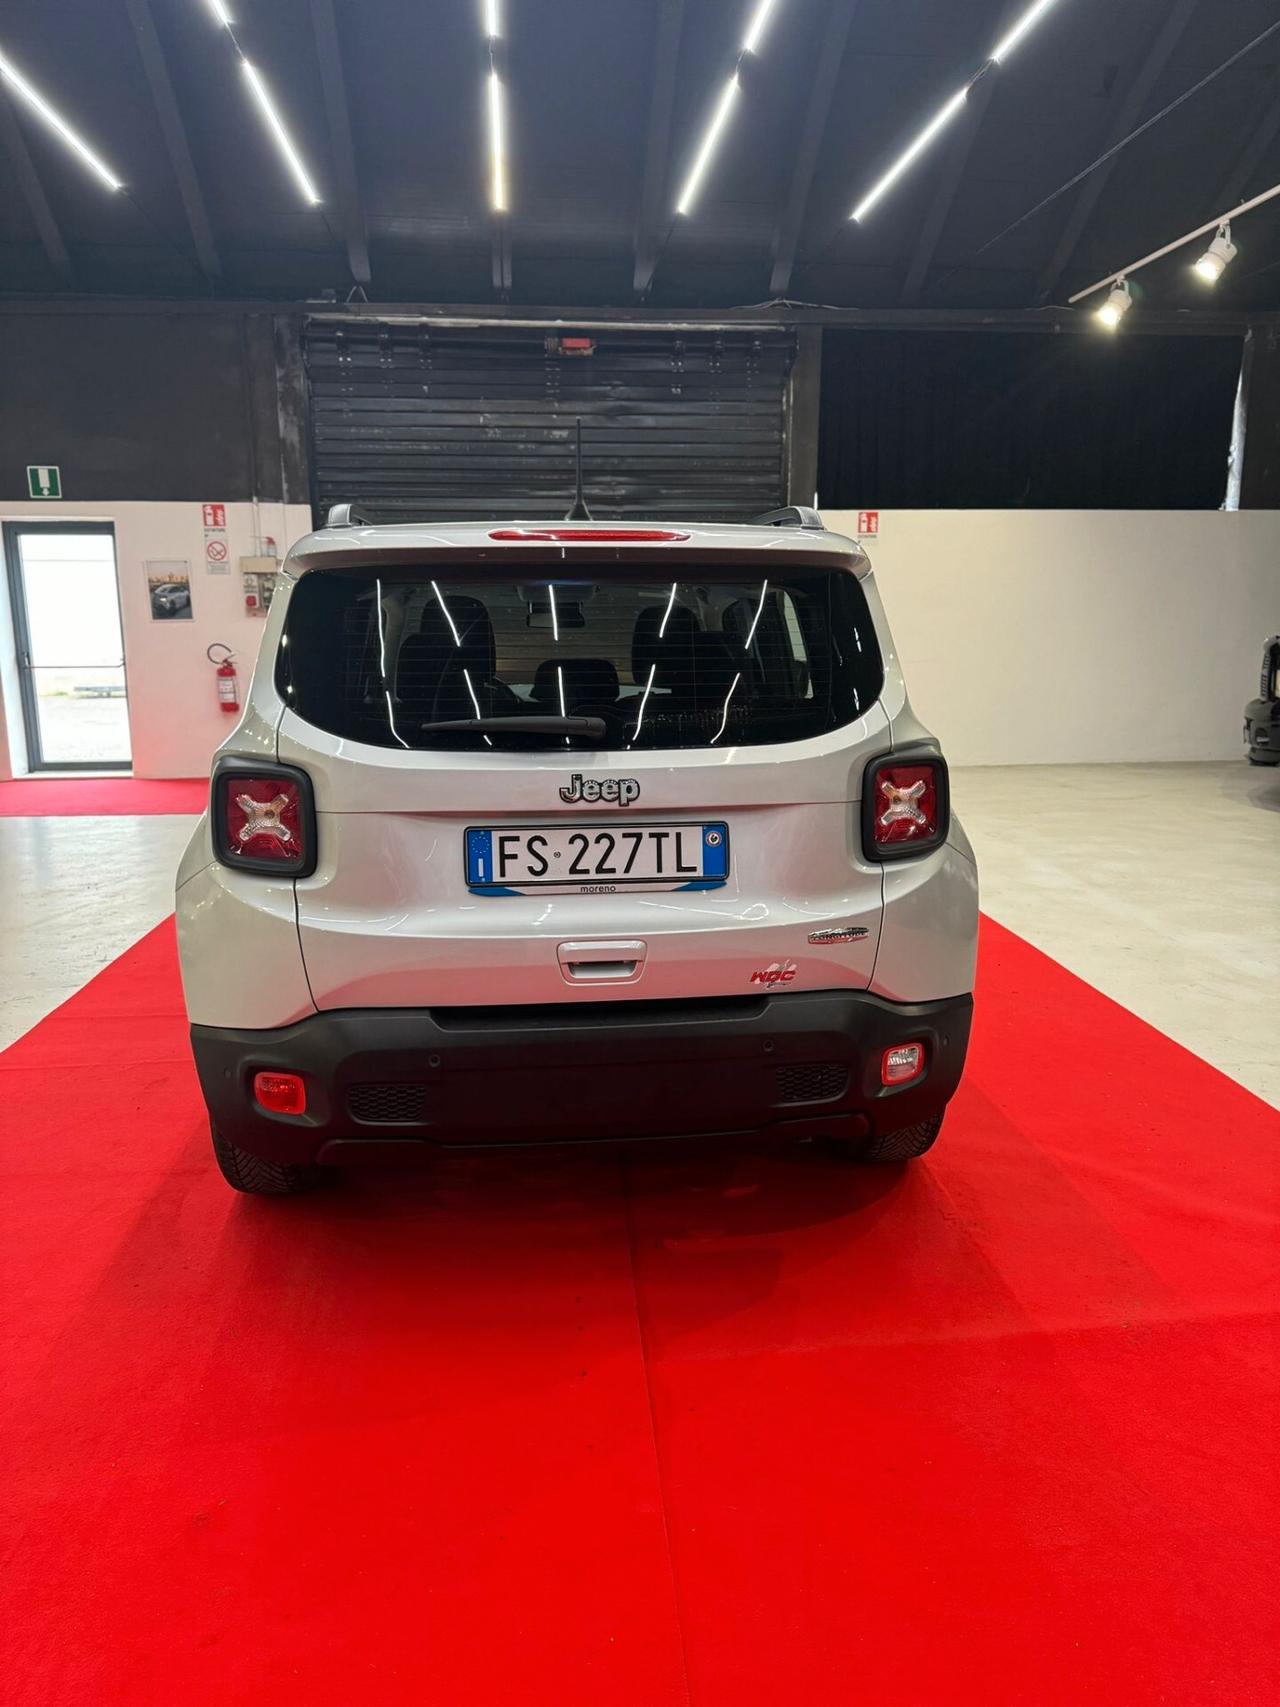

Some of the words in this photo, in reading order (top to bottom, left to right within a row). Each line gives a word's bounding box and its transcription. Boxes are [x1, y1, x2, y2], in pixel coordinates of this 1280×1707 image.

[559, 774, 641, 806] Jeep
[498, 835, 549, 878] FS
[568, 831, 698, 875] 227TL
[580, 885, 617, 893] moreno
